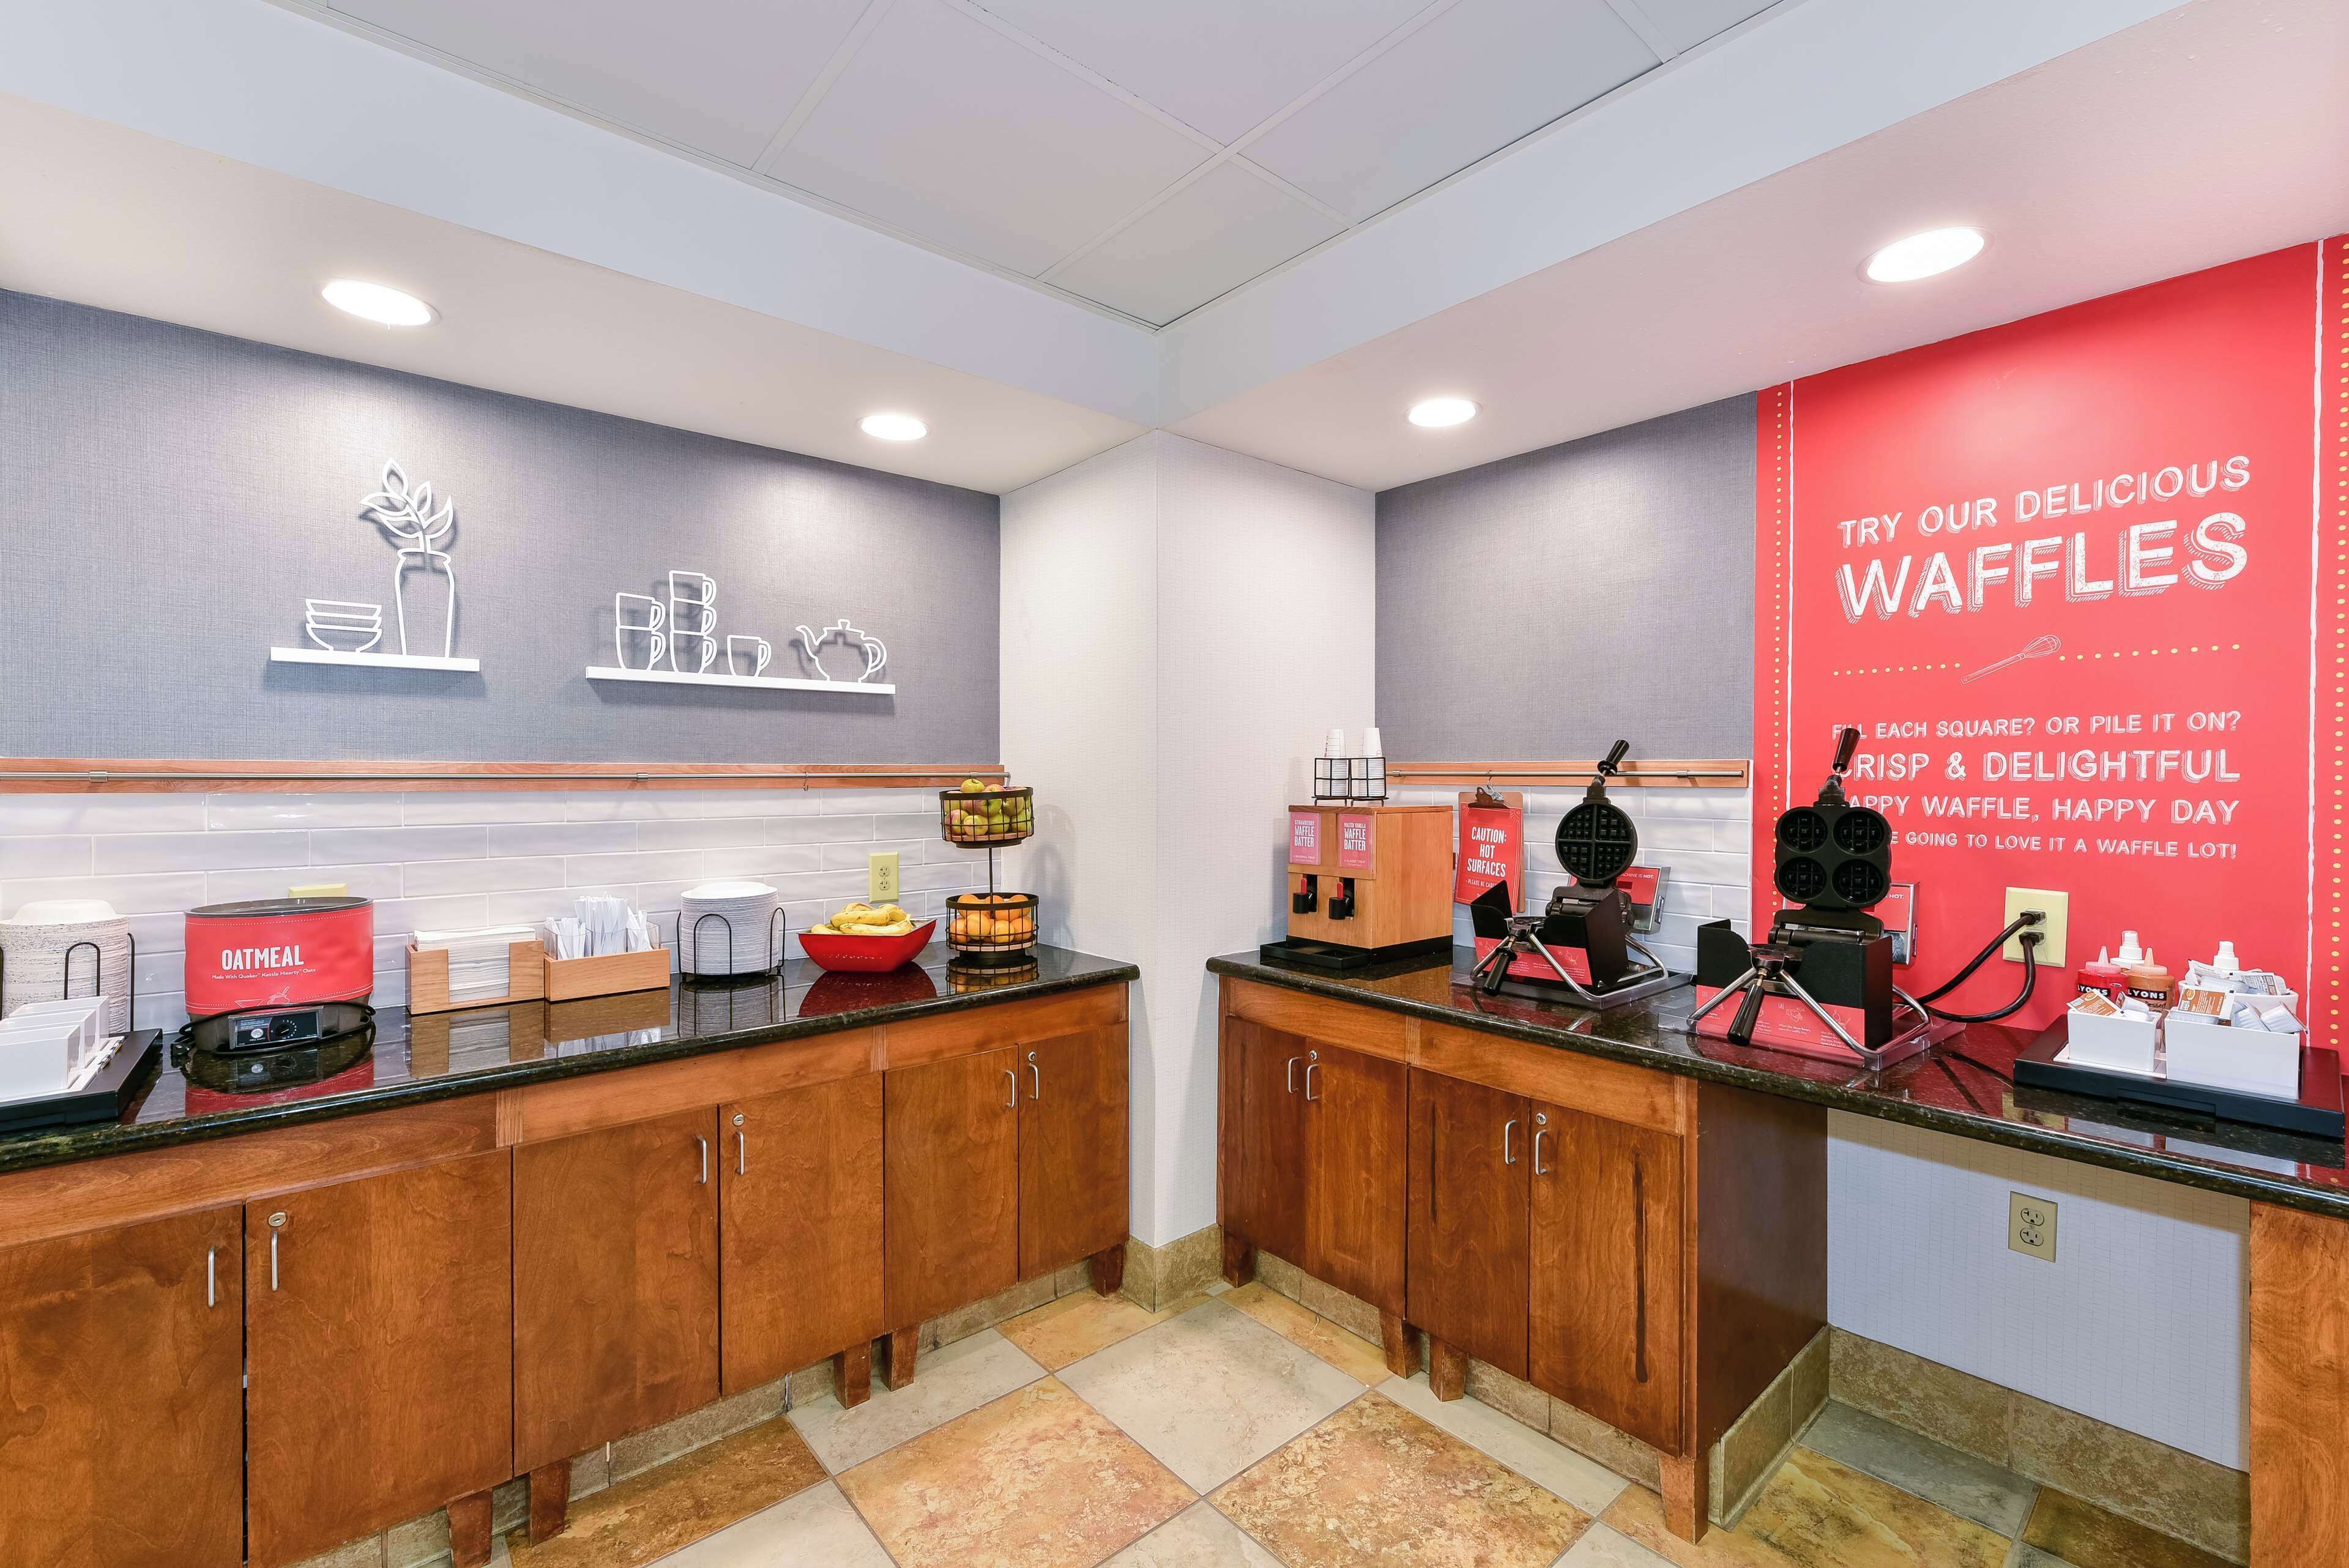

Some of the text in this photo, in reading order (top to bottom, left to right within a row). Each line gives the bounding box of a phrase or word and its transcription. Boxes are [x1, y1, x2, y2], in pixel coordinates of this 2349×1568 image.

[1837, 455, 2250, 548] TRY OUR DELICIOUS
[1836, 512, 2247, 624] WAFFLES
[1832, 710, 2241, 740] FL EACH SQUARE? OR PILE IT ON?
[1945, 751, 1967, 781] &
[1983, 749, 2241, 783] DELIGHTFUL
[1850, 795, 2239, 825] APPY WAFFLE, HAPPY DAY
[1295, 825, 1314, 837] WAFFLE
[1344, 828, 1366, 840] WAFFLE
[1471, 826, 1507, 844] CAUTION:
[1294, 836, 1314, 847] BATTER
[1344, 839, 1366, 851] BATTER
[1905, 831, 1957, 847] GOING
[1965, 833, 1987, 849] TO
[1995, 834, 2041, 850] LOVE
[2049, 837, 2066, 852] IT
[2073, 838, 2087, 853] A
[2096, 838, 2178, 856] WAFFLE
[2188, 842, 2237, 859] LOT!
[1480, 843, 1495, 860] HOT
[1467, 858, 1506, 877] SURFACES
[221, 945, 304, 971] OATMEAL
[2077, 984, 2108, 995] LYOS
[2128, 989, 2164, 1000] LYONS
